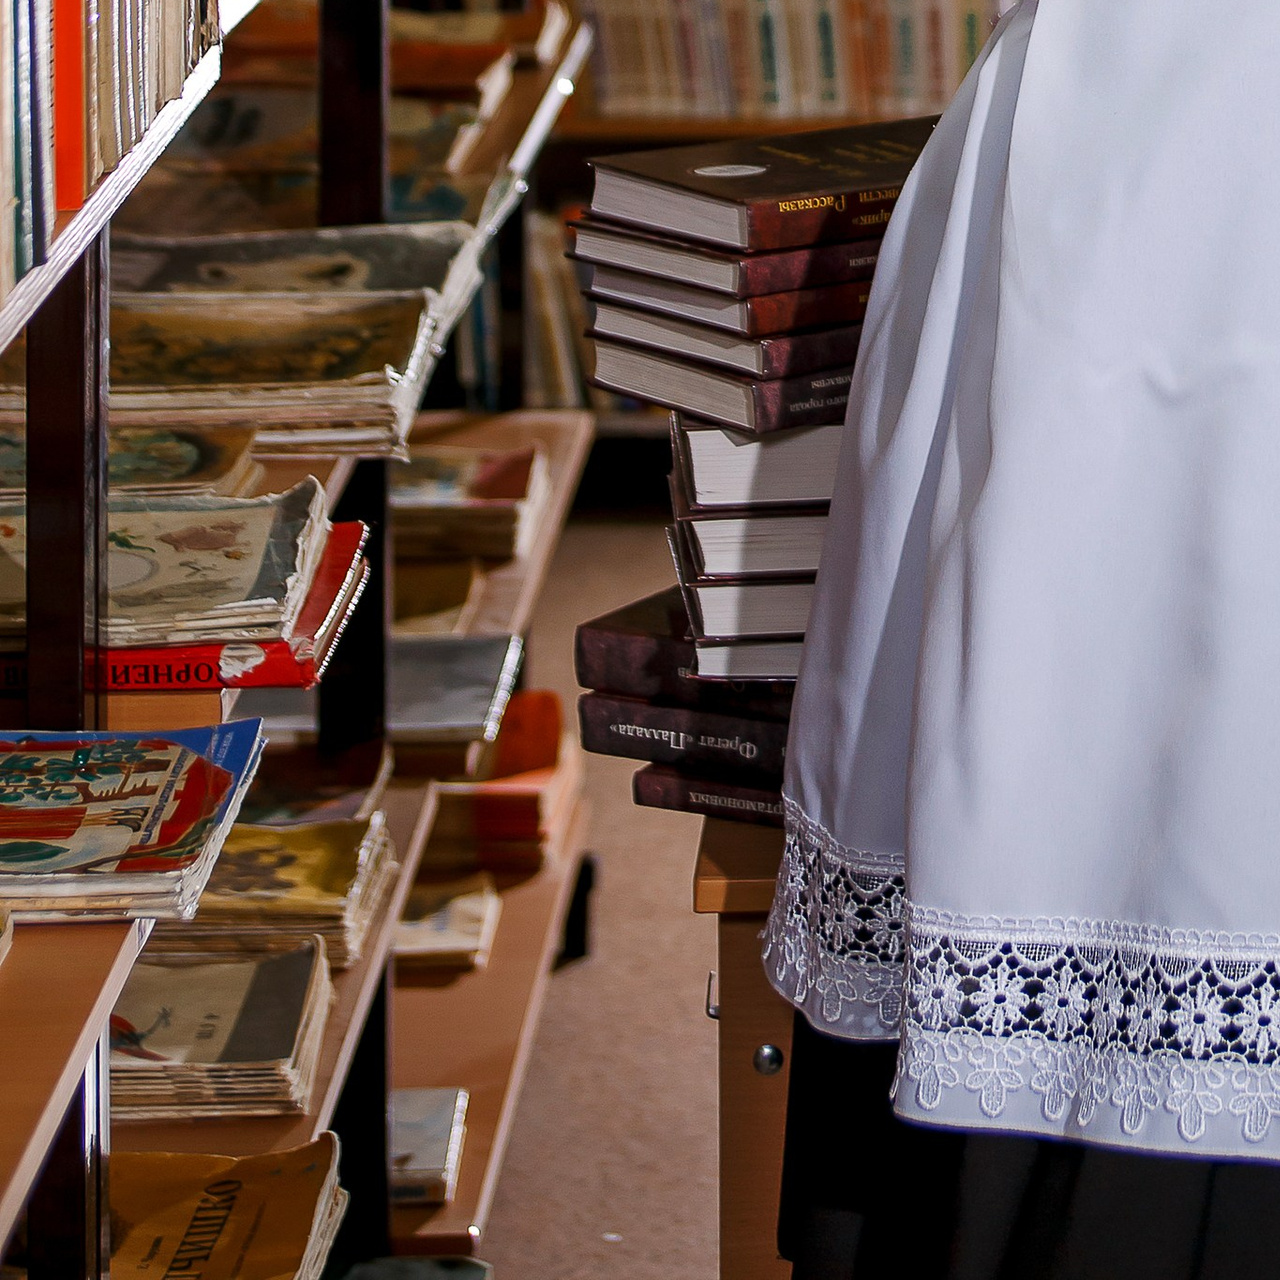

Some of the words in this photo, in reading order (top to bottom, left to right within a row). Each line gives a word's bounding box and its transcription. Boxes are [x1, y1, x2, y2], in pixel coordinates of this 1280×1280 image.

[778, 194, 846, 214] Рассказы
[789, 398, 824, 413] города
[609, 723, 694, 747] «Паллада»
[698, 734, 757, 757] Фрегат
